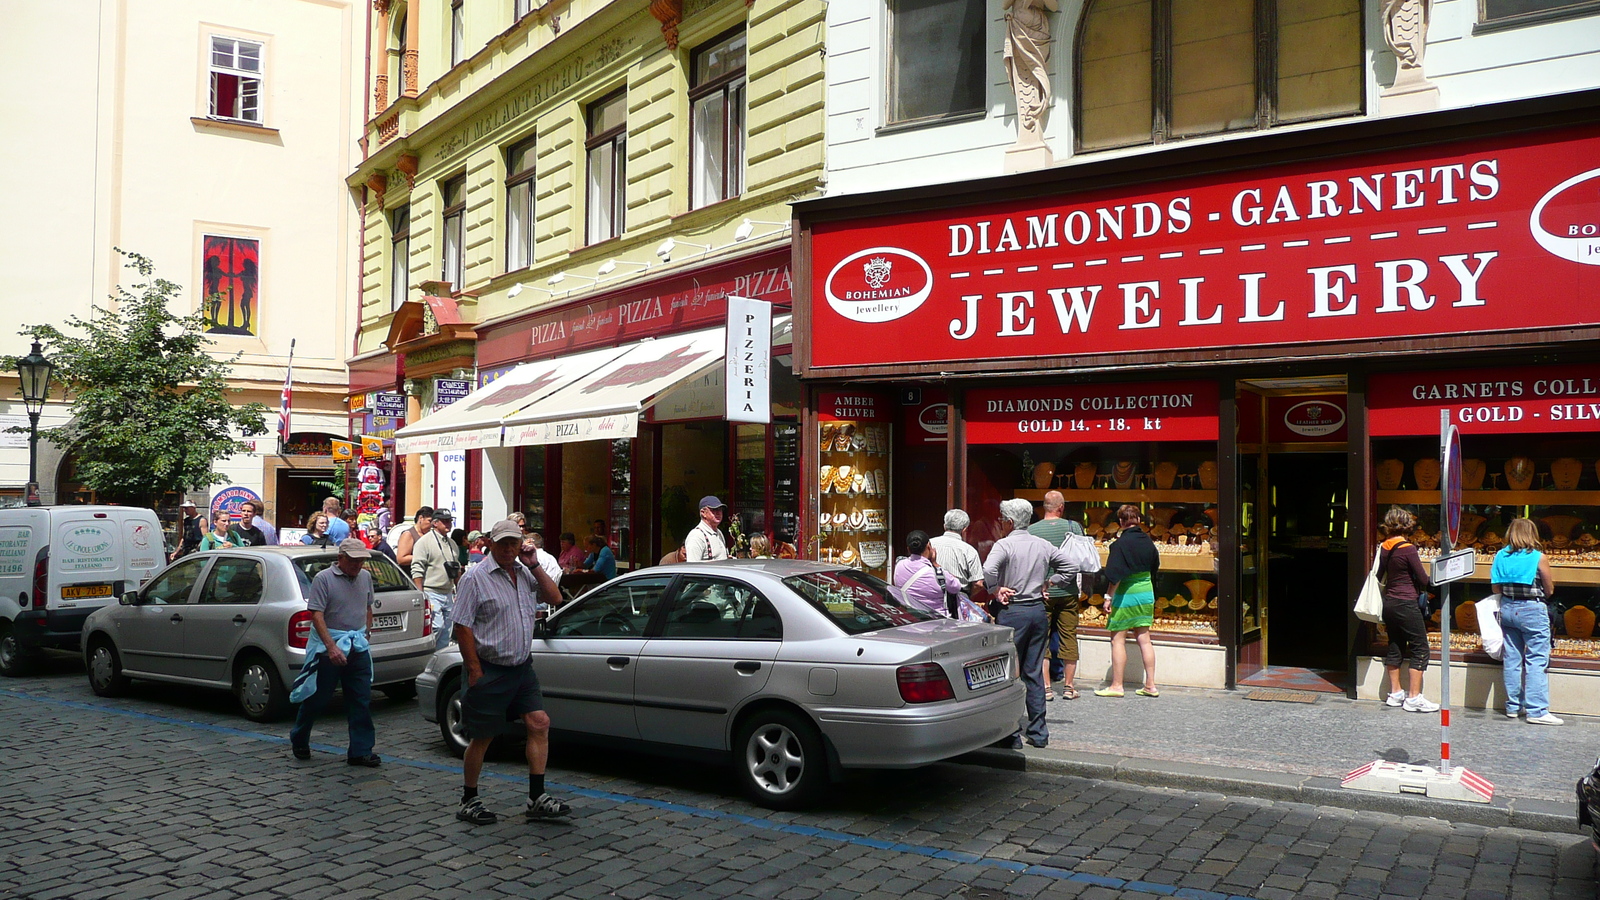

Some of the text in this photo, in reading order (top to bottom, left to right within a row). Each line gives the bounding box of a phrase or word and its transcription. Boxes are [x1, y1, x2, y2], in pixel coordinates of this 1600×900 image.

[948, 196, 1193, 258] DIAMONDS
[1231, 159, 1500, 228] GARNETS
[733, 264, 792, 300] PIZZA
[844, 285, 912, 299] BOHEMIAN
[948, 251, 1499, 341] JEWELLERY
[618, 296, 664, 326] PIZZA
[855, 303, 901, 316] Jewellery
[531, 319, 566, 346] PIZZA
[743, 314, 755, 412] PIZZERIA
[908, 391, 914, 401] 8
[1411, 379, 1524, 400] GARNETS
[834, 396, 875, 406] AMBER
[986, 393, 1194, 415] DIAMONDS COLLECTION
[834, 407, 876, 418] SILVER
[1458, 403, 1523, 423] GOLD
[556, 423, 580, 437] PIZZA
[1017, 418, 1063, 433] GOLD
[1143, 417, 1162, 430] kt
[437, 435, 455, 447] PIZZA
[443, 454, 465, 463] OPEN
[17, 530, 30, 538] BAR
[65, 588, 82, 597] AKV
[378, 615, 398, 627] 5538
